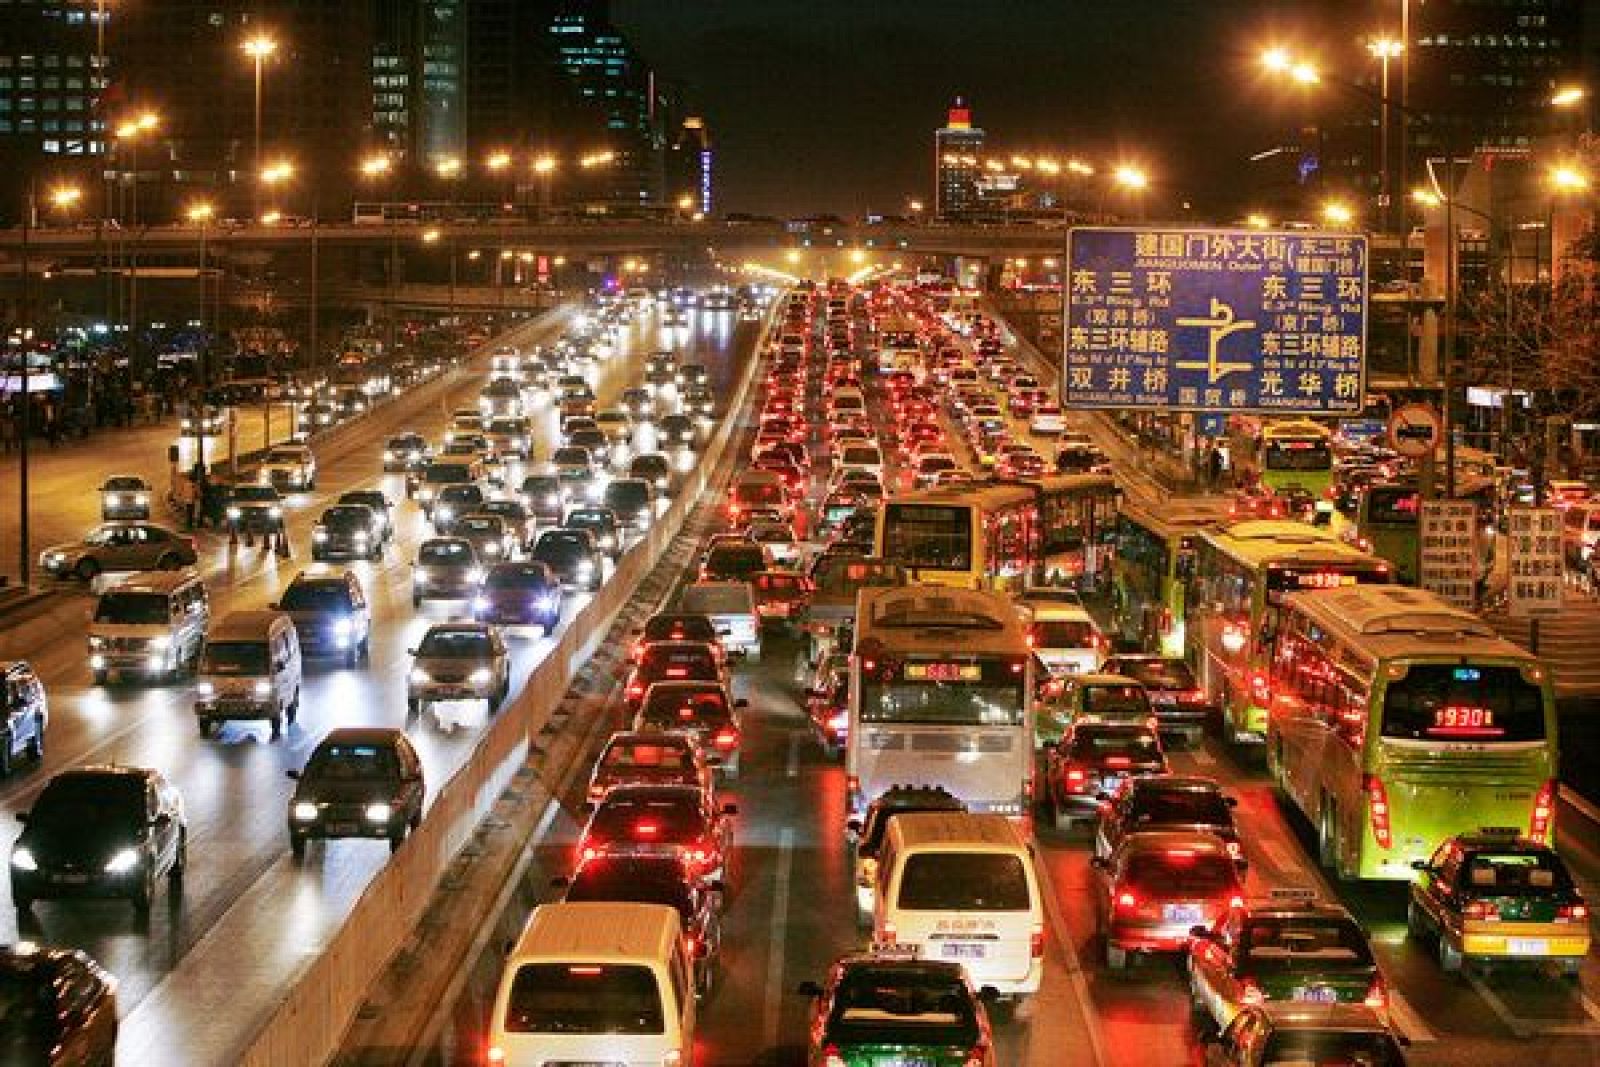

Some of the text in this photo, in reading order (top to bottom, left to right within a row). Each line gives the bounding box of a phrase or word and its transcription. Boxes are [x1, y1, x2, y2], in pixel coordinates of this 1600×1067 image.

[1135, 234, 1287, 259] 建国门外大街
[1072, 269, 1172, 295] 东三环
[1262, 274, 1361, 301] 东三环
[1069, 327, 1169, 353] 东三环辅路
[1263, 331, 1361, 358] 东三环辅路
[1069, 367, 1169, 392] 双井桥
[1259, 371, 1360, 398] 光华桥
